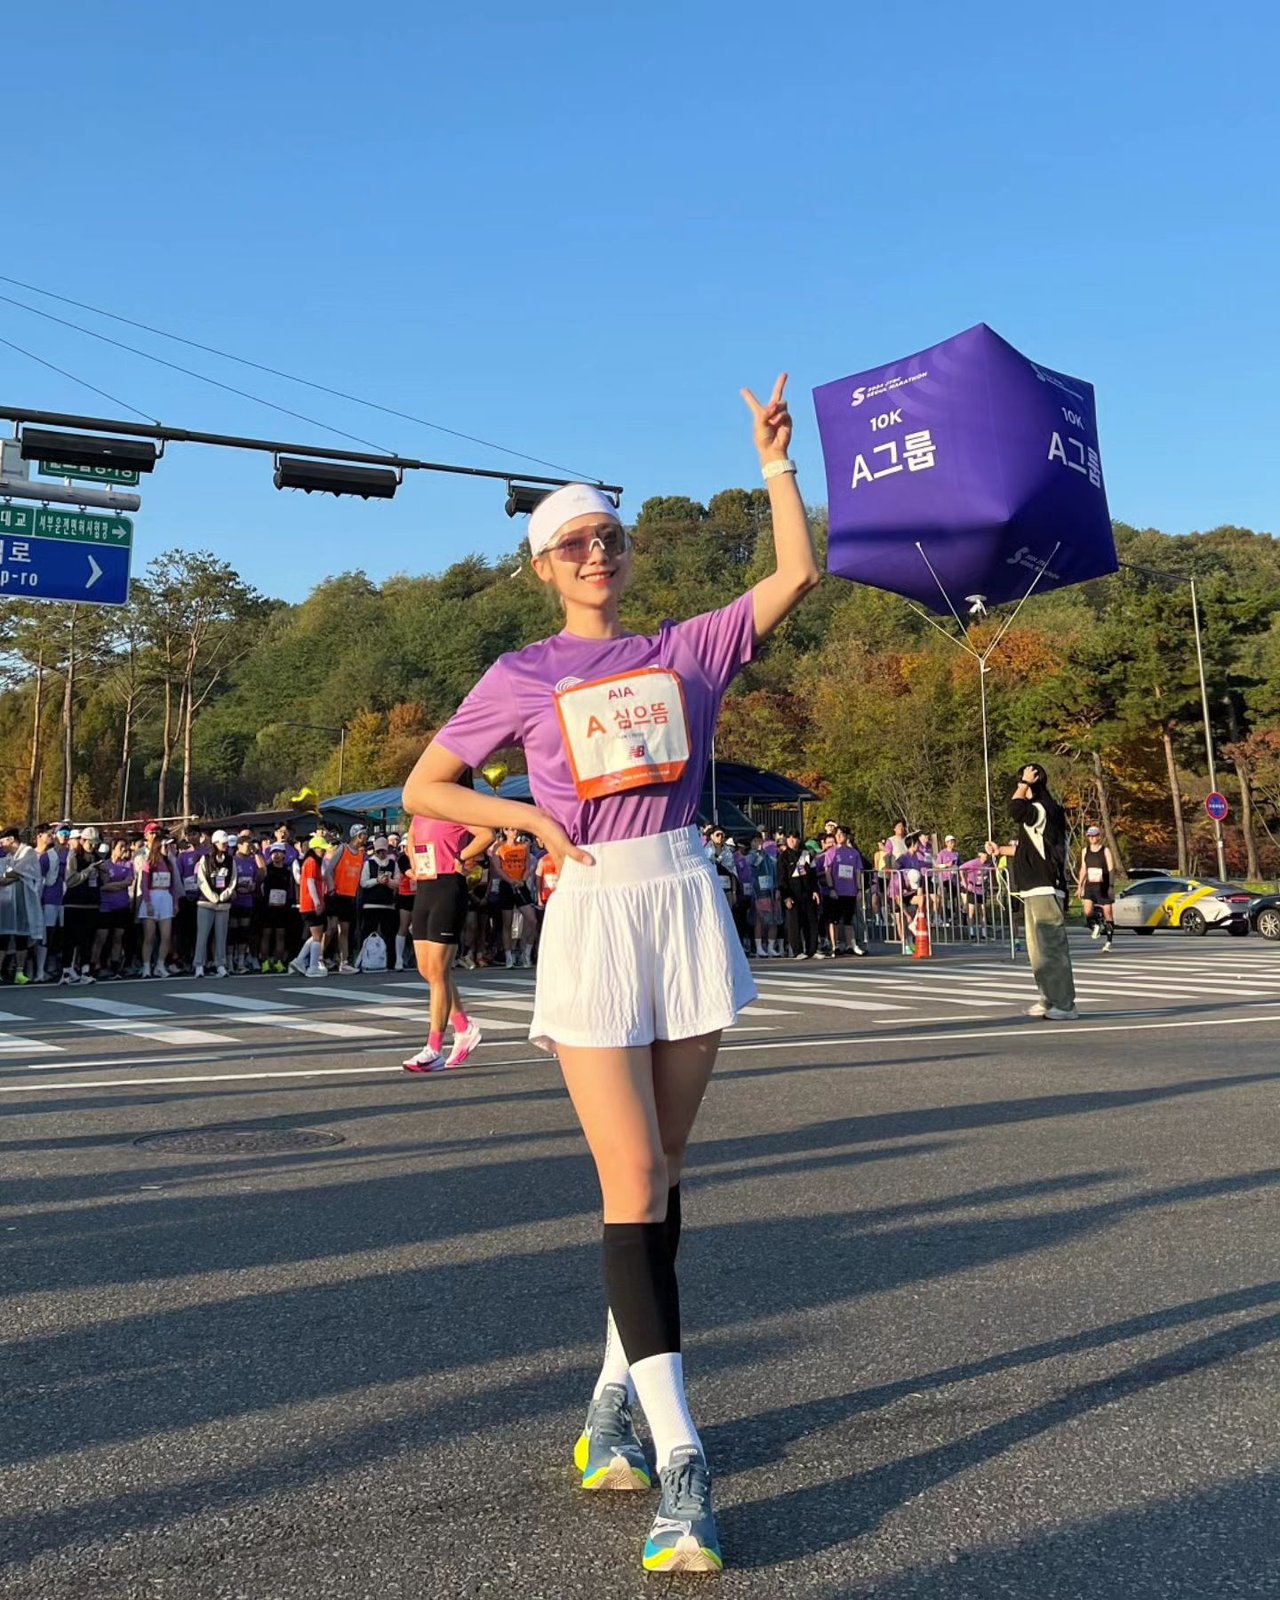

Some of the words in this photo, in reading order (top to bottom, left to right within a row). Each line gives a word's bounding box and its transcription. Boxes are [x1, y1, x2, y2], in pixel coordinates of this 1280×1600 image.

[888, 371, 928, 390] MARATHON
[870, 408, 903, 432] 10K
[1061, 407, 1085, 431] 10K
[851, 429, 937, 489] A그룹
[1047, 431, 1101, 489] A그룹
[608, 686, 635, 700] AIA
[587, 715, 607, 738] A
[614, 702, 668, 730] 심으뜸
